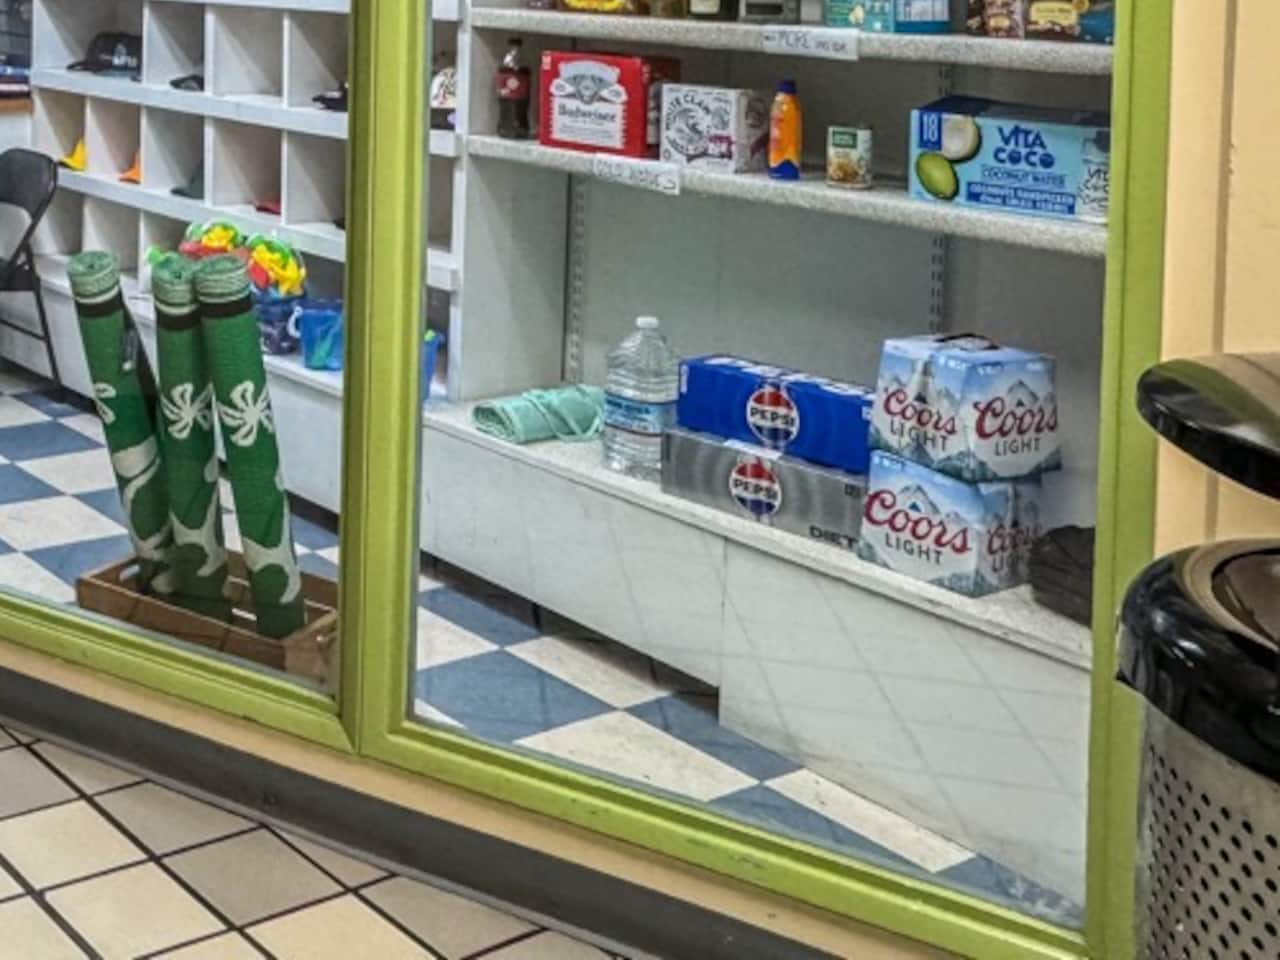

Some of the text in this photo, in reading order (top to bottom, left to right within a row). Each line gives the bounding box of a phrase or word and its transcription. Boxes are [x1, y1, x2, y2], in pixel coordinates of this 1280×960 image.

[922, 113, 939, 142] 18
[997, 124, 1047, 151] VITA
[993, 146, 1056, 169] COCO
[749, 407, 796, 426] PEPSI
[883, 386, 958, 435] Coors
[973, 396, 1059, 440] Coors
[890, 420, 948, 452] LIGHT
[994, 437, 1041, 457] LIGHT
[733, 478, 778, 500] PEPSI
[863, 490, 972, 554] Coors
[884, 532, 944, 566] LIGHT
